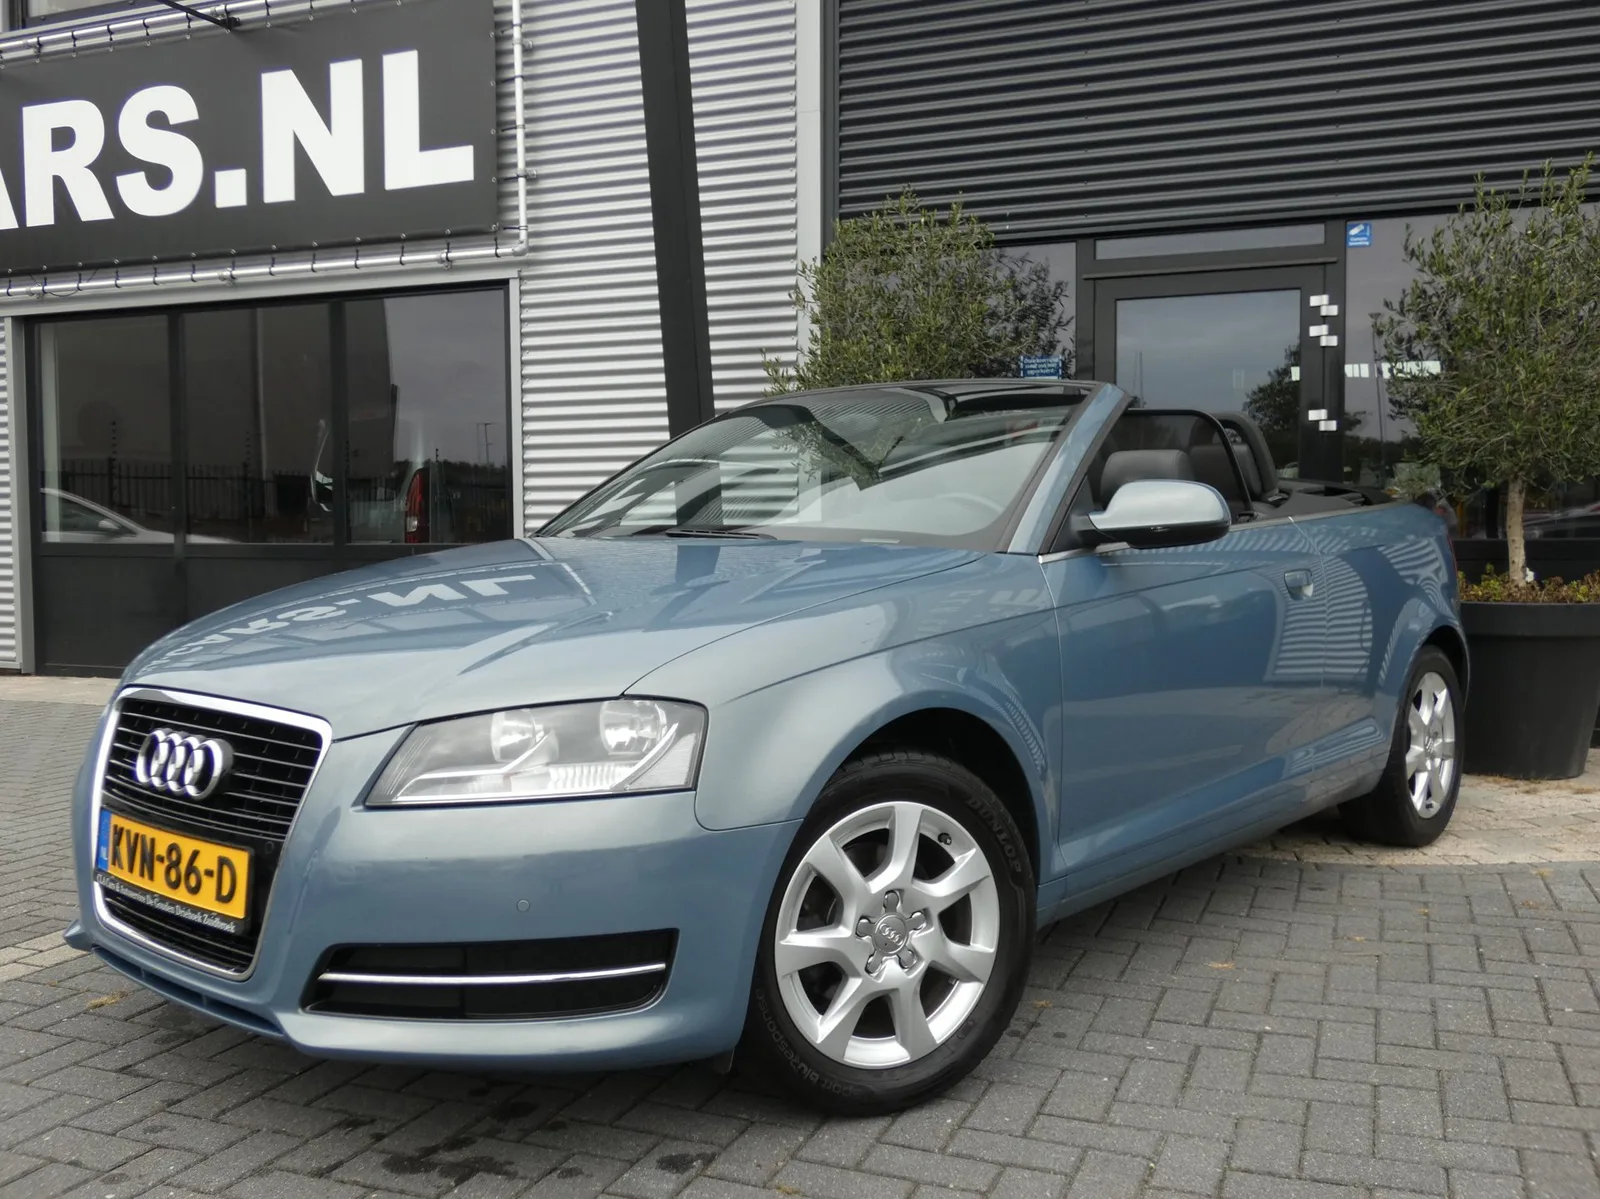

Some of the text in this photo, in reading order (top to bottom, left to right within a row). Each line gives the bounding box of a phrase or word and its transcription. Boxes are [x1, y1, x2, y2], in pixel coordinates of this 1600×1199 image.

[0, 49, 475, 230] RS.NL
[110, 823, 238, 905] KVN-86-D
[964, 797, 1022, 873] DUNLOP
